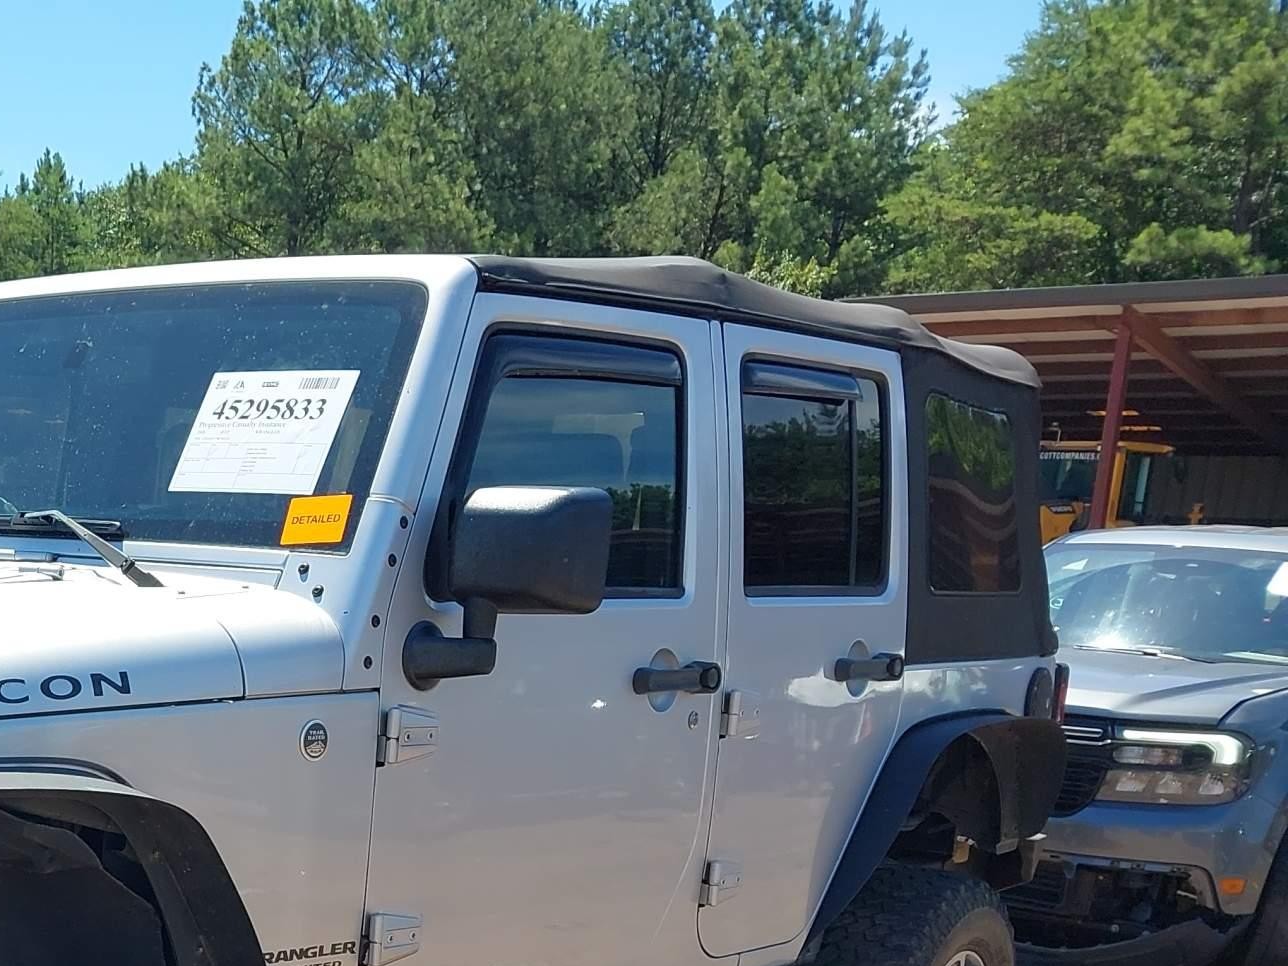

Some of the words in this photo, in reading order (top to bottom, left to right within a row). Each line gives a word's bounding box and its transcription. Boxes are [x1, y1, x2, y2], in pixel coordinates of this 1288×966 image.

[212, 398, 328, 420] 45295833
[291, 513, 341, 525] DETAILED
[263, 941, 357, 964] RANGLER
